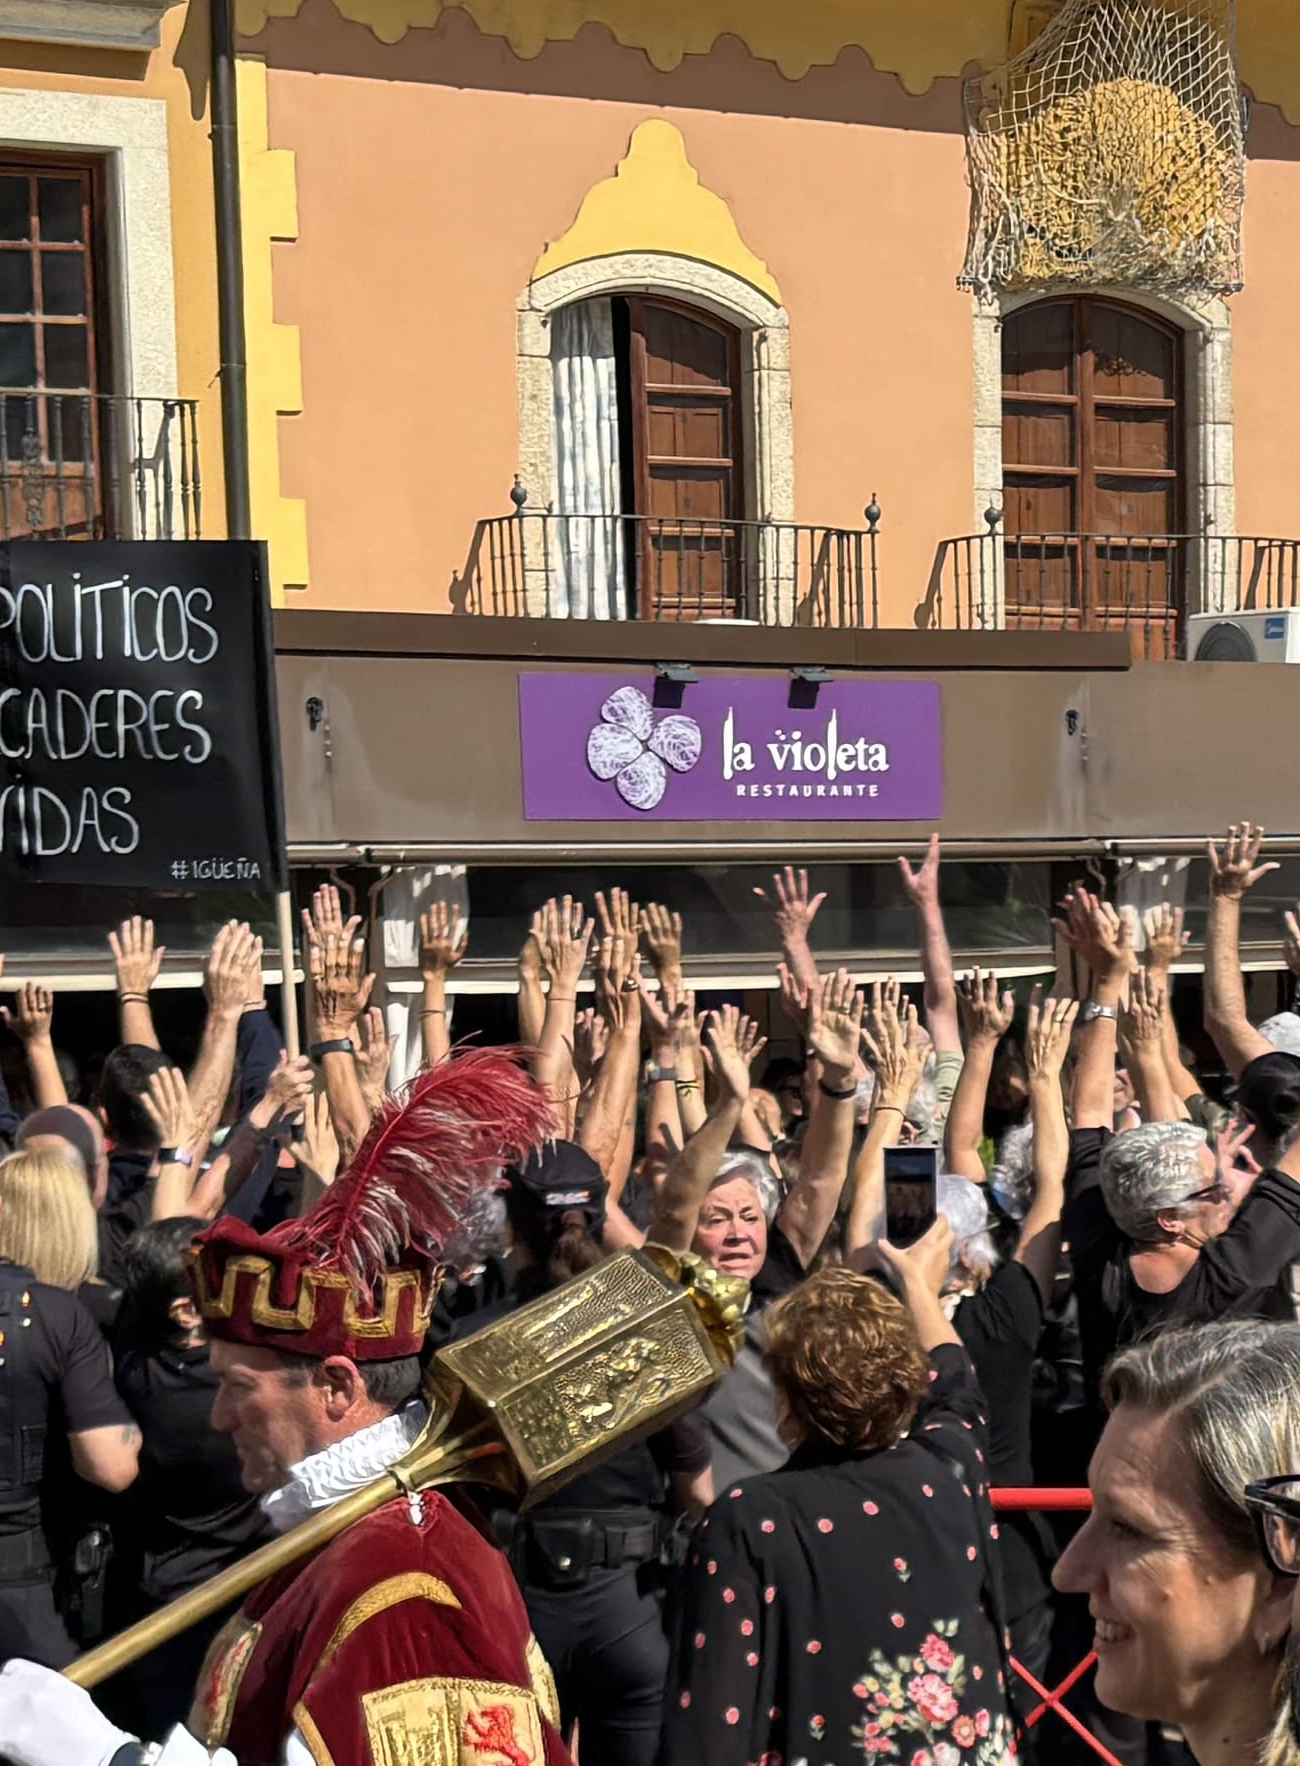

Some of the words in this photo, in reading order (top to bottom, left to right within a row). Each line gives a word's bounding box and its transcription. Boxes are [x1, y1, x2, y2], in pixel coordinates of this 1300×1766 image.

[723, 706, 756, 781] la
[766, 708, 890, 781] violeta
[736, 784, 880, 797] RESTAURANTE
